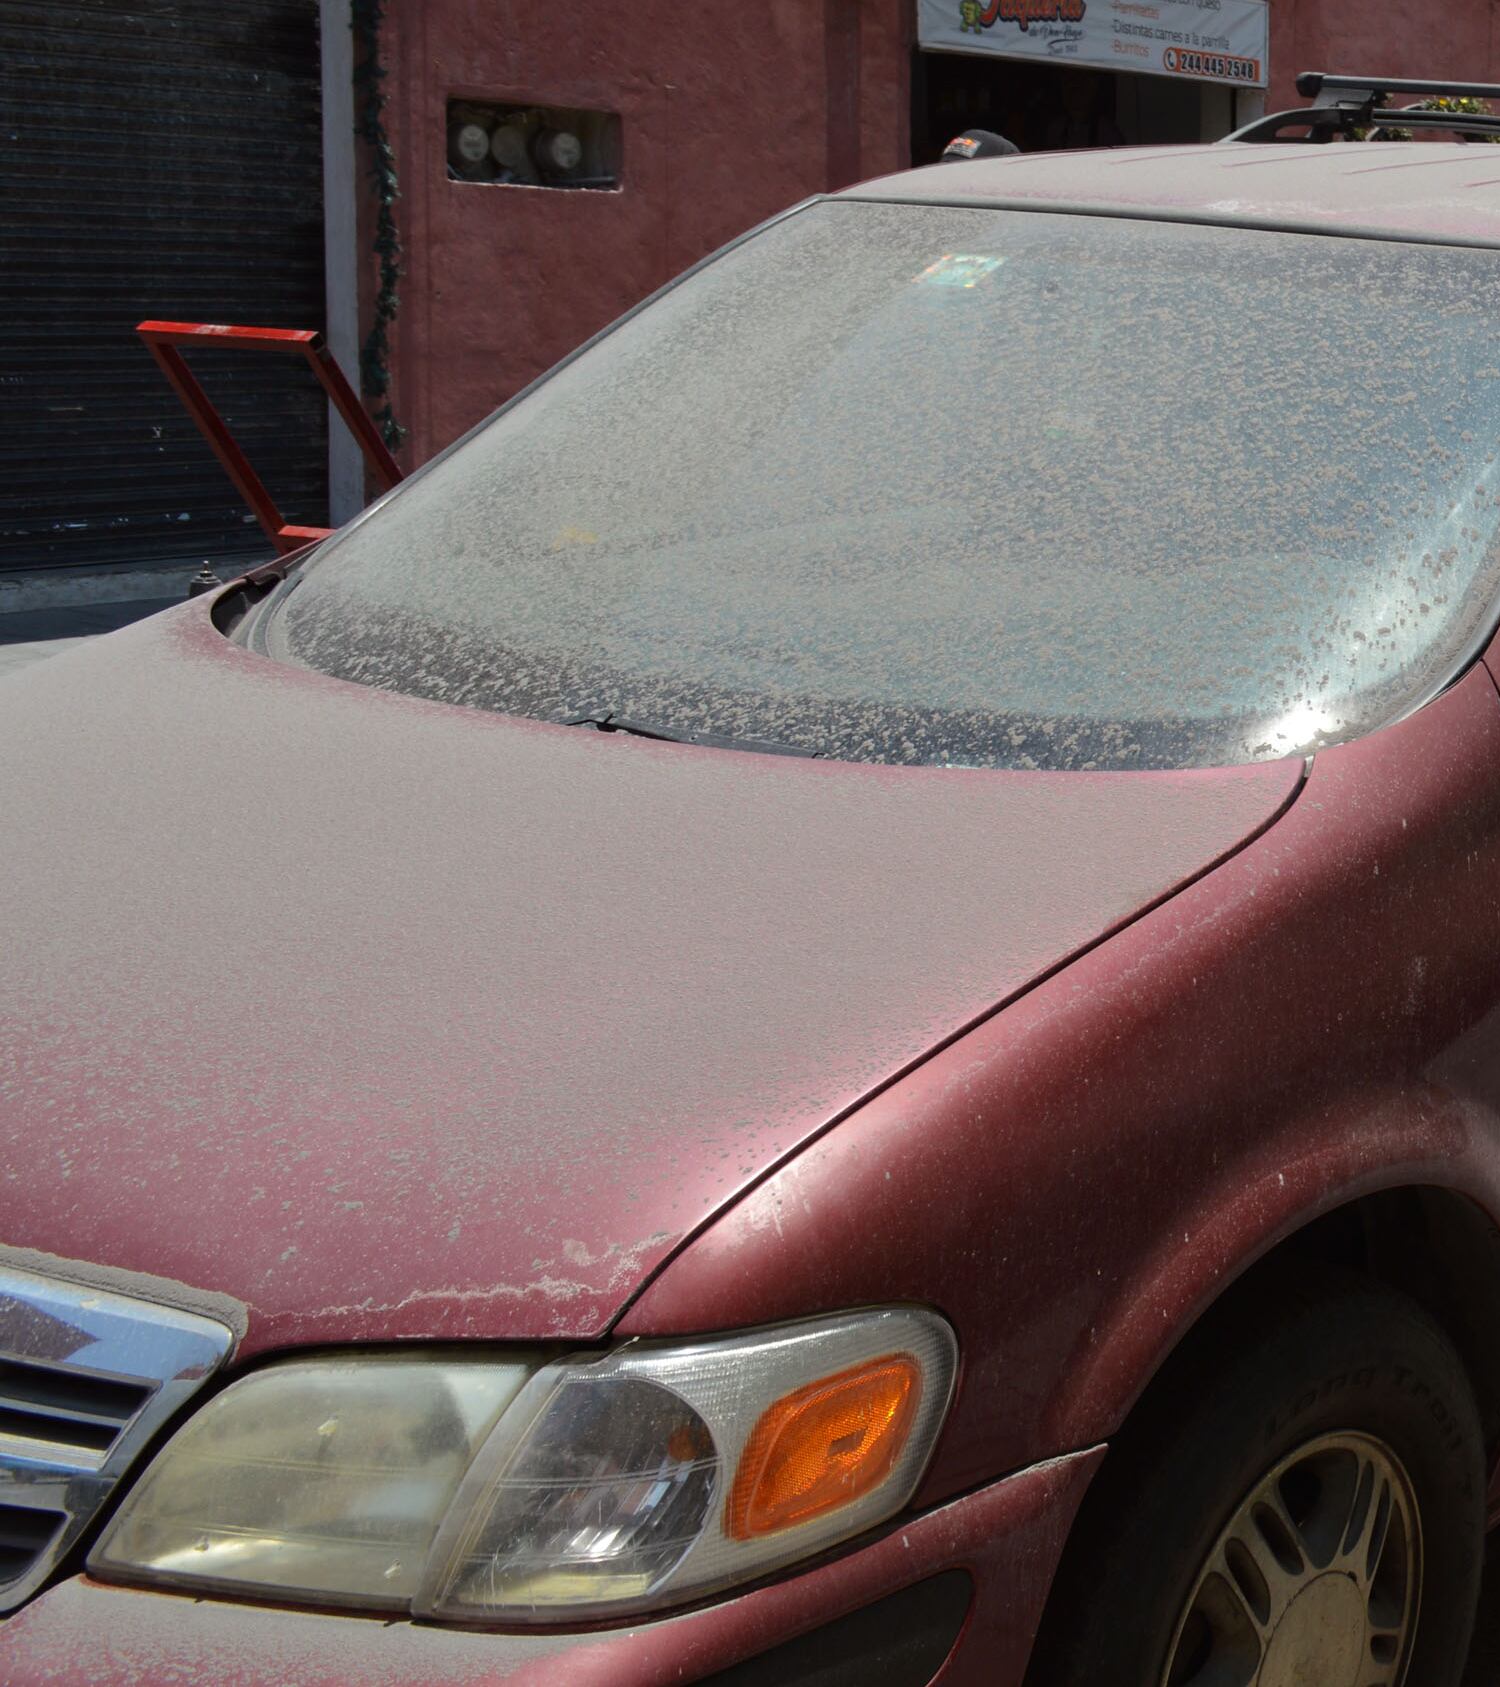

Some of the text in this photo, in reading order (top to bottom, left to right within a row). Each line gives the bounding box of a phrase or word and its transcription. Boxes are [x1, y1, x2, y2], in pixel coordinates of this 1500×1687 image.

[1156, 28, 1183, 43] carnes
[1185, 33, 1191, 44] a
[1192, 32, 1200, 46] la
[1181, 53, 1255, 79] 244 445 2548
